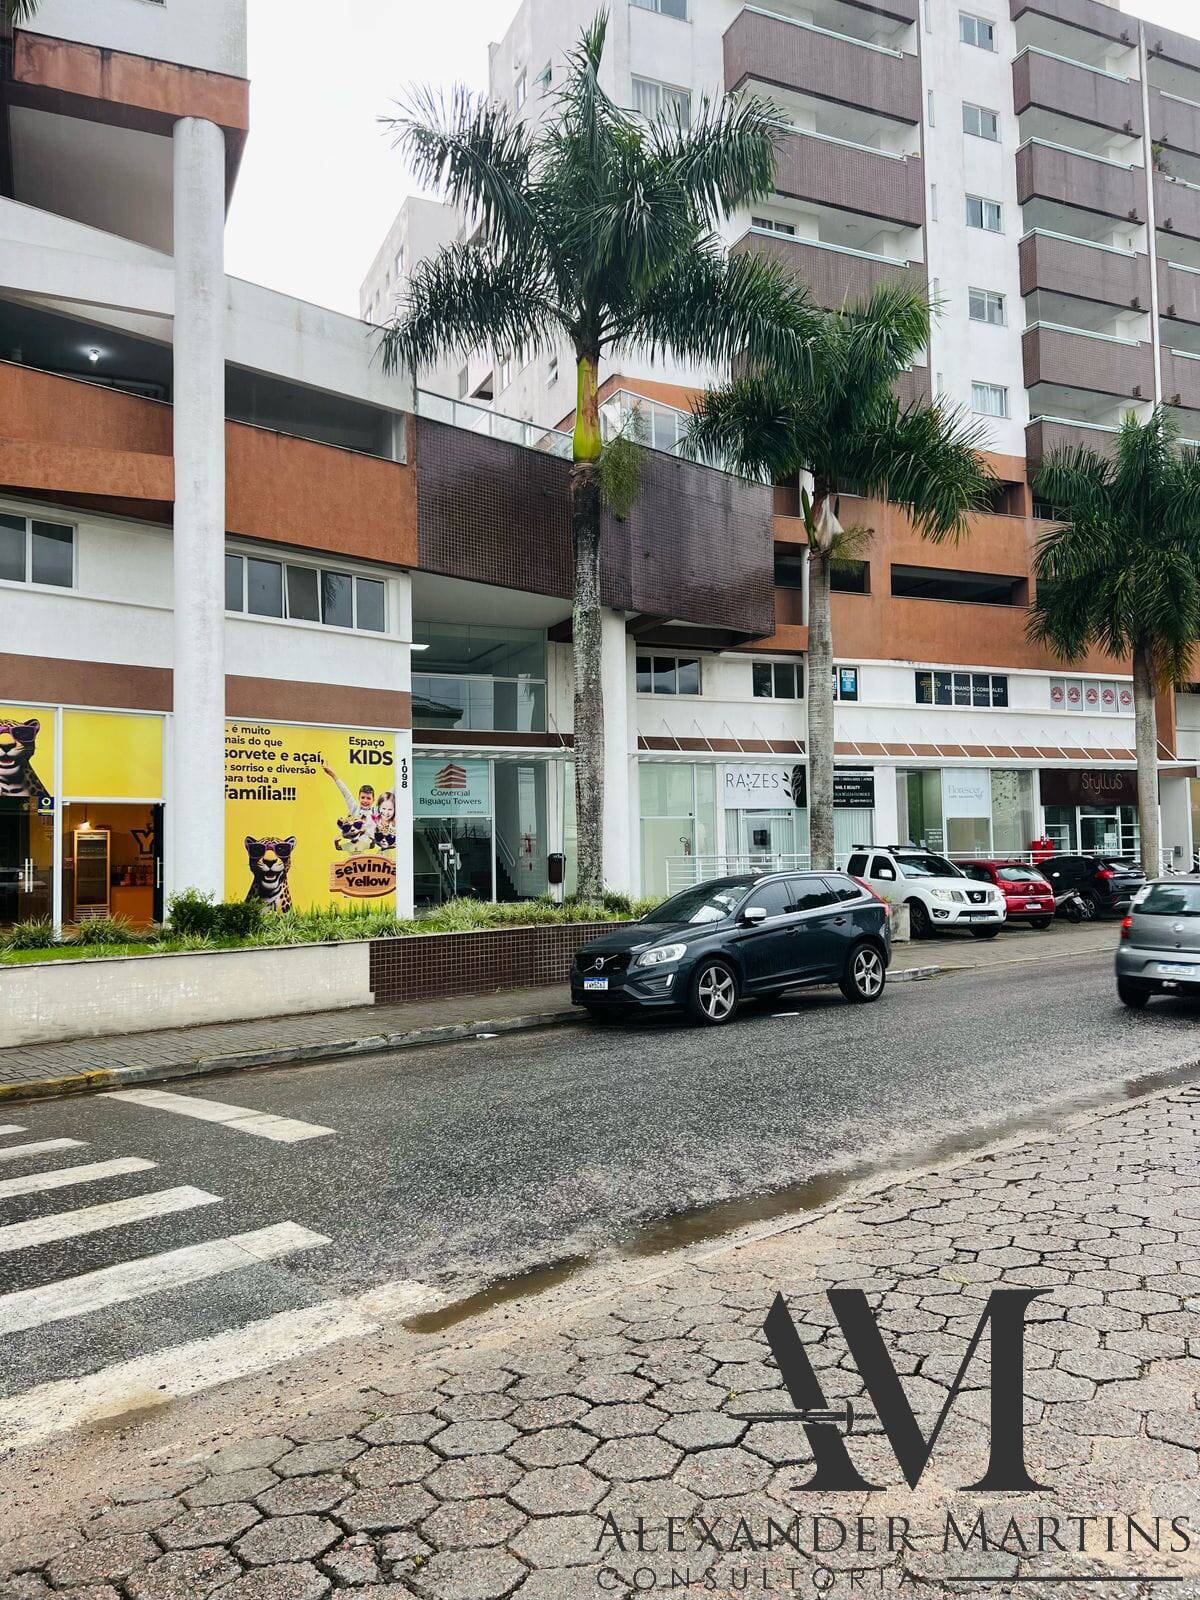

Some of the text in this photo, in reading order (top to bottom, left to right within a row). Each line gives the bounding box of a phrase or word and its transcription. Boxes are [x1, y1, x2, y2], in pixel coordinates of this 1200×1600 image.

[241, 726, 271, 735] muito
[248, 736, 261, 745] do
[264, 739, 283, 748] que
[349, 736, 385, 749] Espaço
[280, 752, 289, 761] e
[349, 749, 393, 766] KIDS
[230, 763, 264, 772] sorriso
[276, 764, 316, 775] diversão
[246, 774, 269, 783] toda
[430, 788, 471, 797] Comercial
[420, 797, 451, 806] Biguaçu
[346, 876, 391, 887] Yellow
